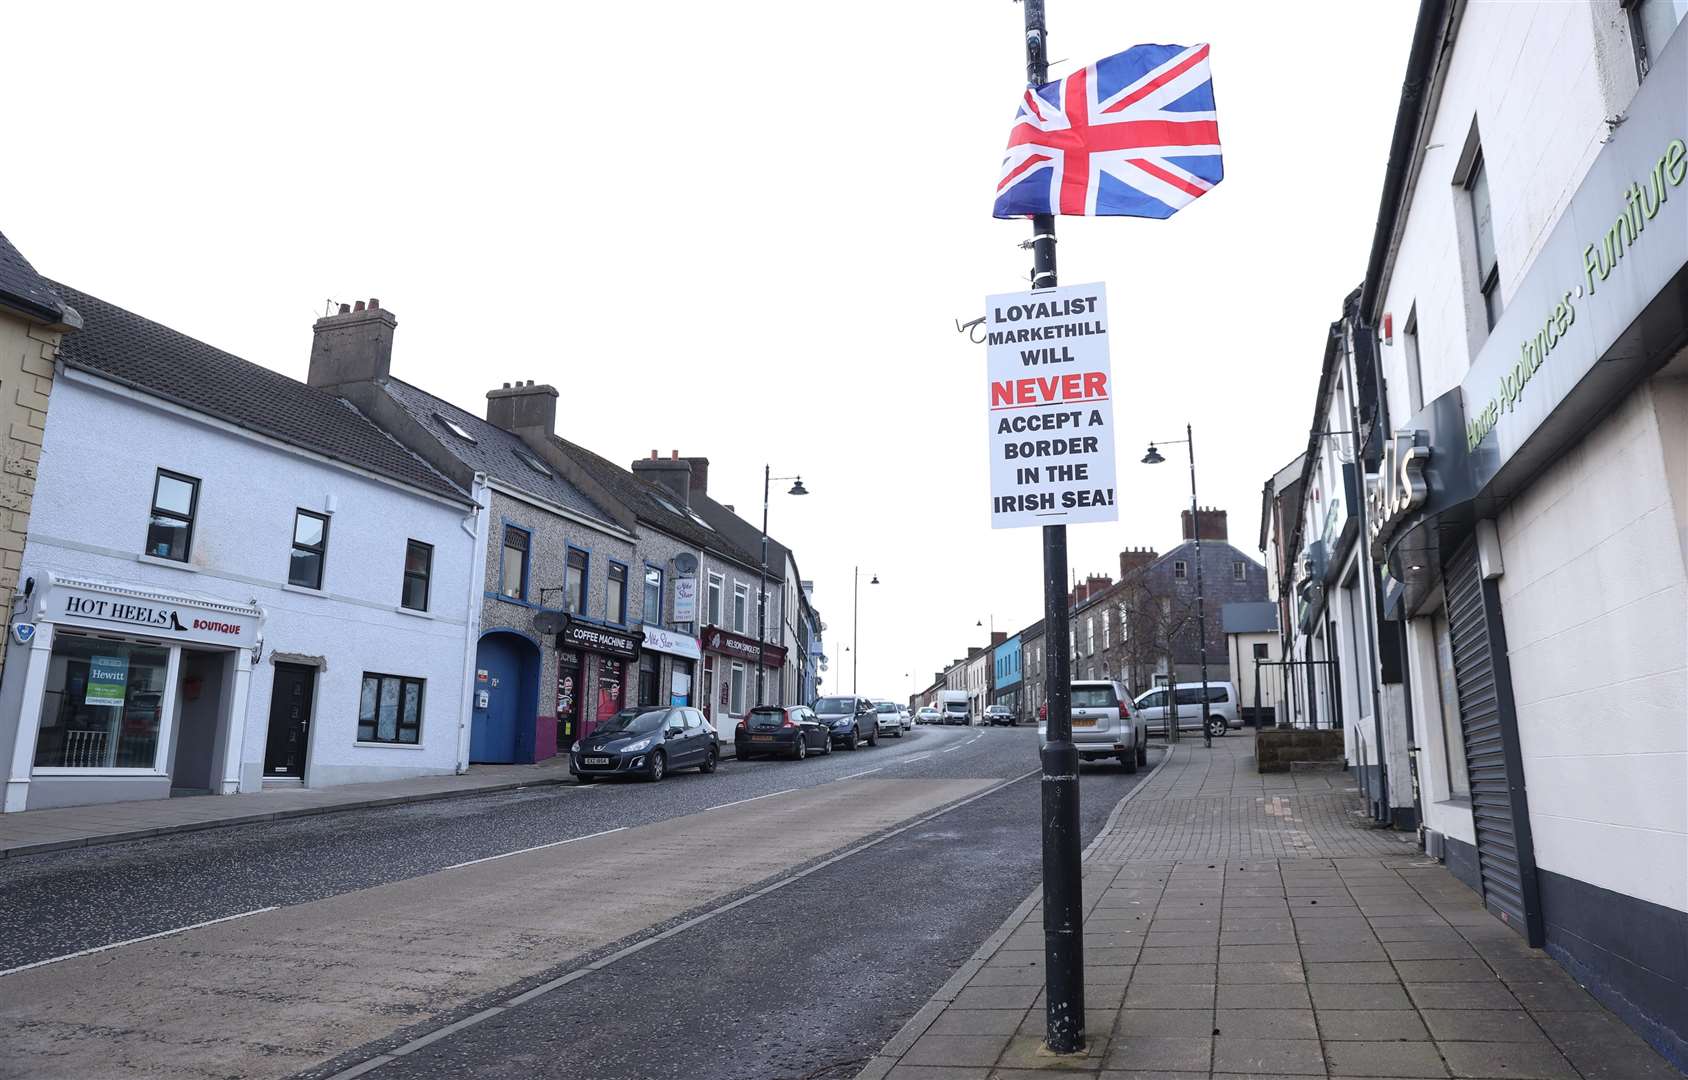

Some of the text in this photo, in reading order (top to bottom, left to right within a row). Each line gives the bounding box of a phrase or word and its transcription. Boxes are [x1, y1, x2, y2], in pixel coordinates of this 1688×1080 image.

[1466, 139, 1688, 454] Home Appliances Furniture
[994, 296, 1098, 323] LOYALIST
[988, 320, 1106, 346] MARKETHILL
[1020, 346, 1075, 366] WILL
[991, 371, 1108, 407] NEVER
[997, 409, 1104, 434] ACCEPT A
[1004, 436, 1098, 460] BORDER
[1016, 463, 1089, 485] IN THE
[993, 488, 1114, 514] IRISH SEA!
[65, 596, 241, 635] HOT HEELS BOUTIQUE
[573, 628, 599, 643] COFFEE
[598, 633, 625, 649] MACHINE
[725, 639, 742, 651] NELSON
[92, 669, 125, 681] Hewitt
